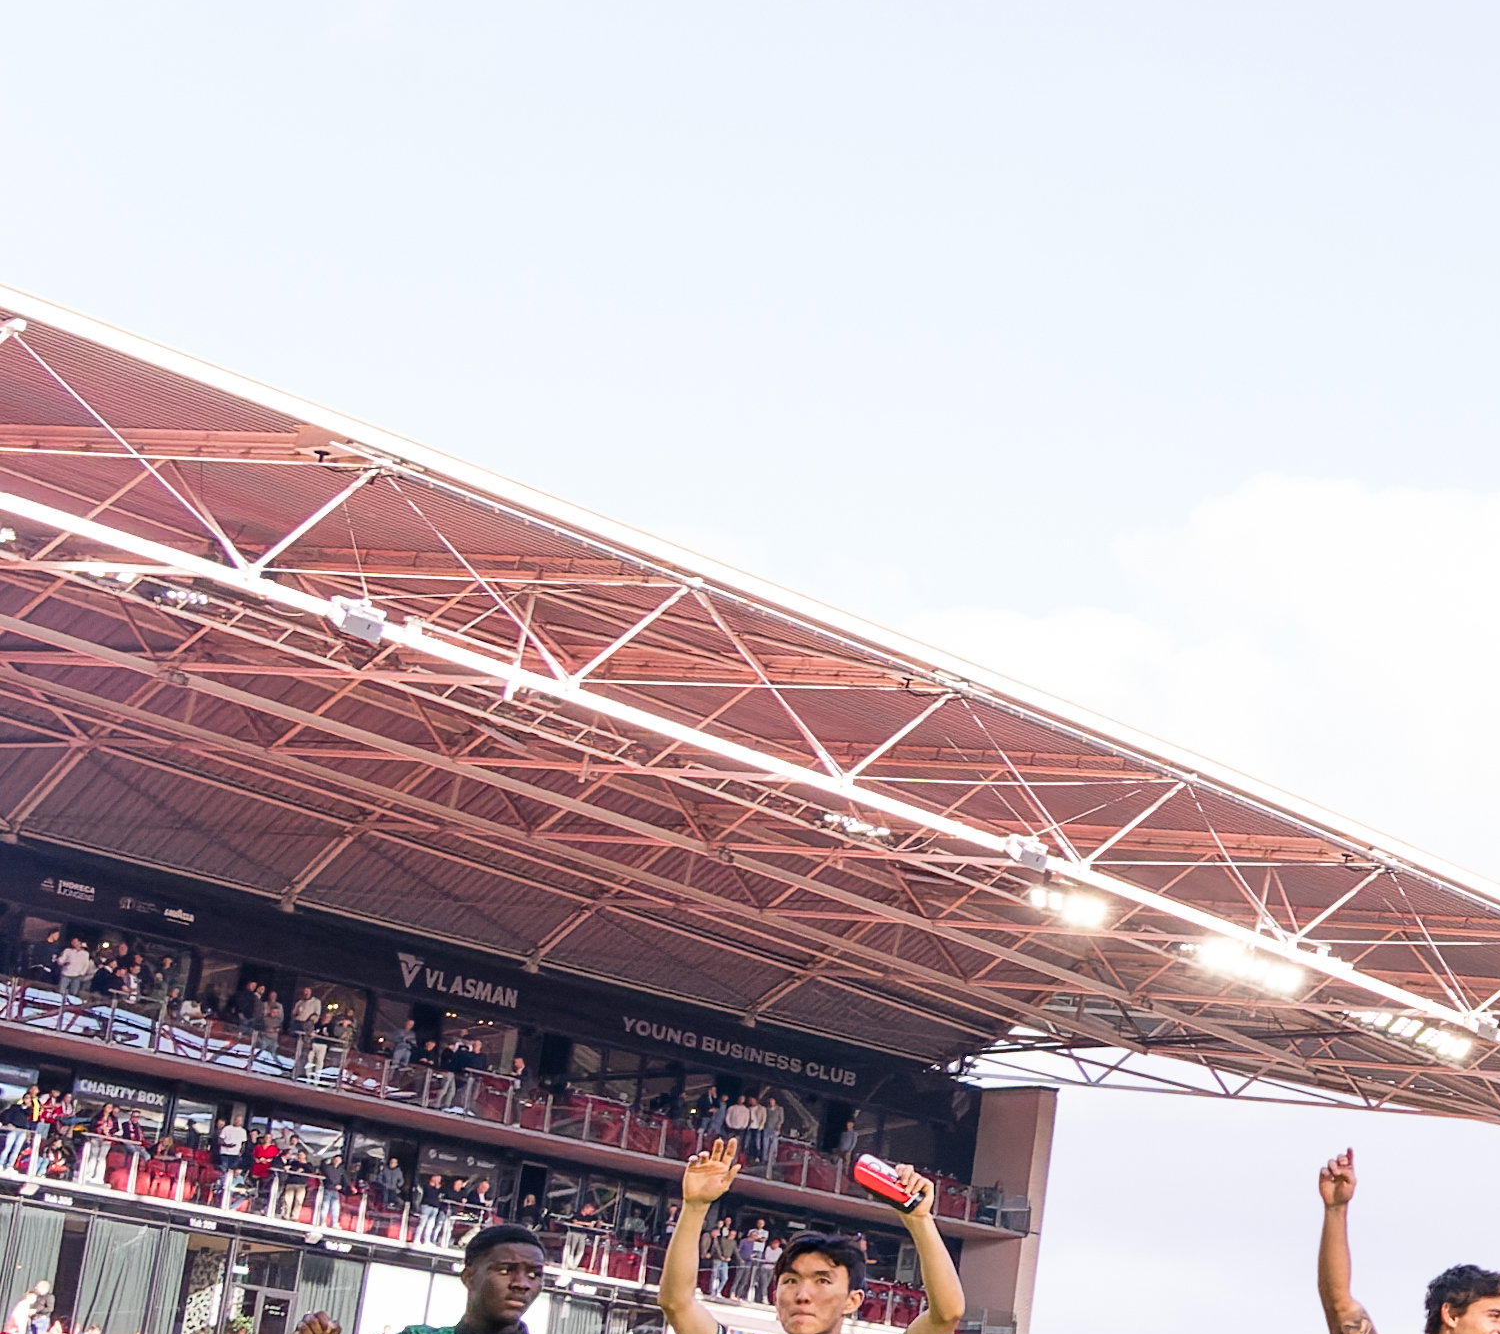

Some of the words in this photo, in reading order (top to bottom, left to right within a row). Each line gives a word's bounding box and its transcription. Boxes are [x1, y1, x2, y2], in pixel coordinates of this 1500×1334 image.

[426, 968, 518, 1009] VLASMAN
[623, 1016, 697, 1048] YOUNG
[702, 1037, 802, 1072] BUSINESS
[805, 1061, 856, 1087] CLUB
[79, 1078, 136, 1101] CHARITY
[137, 1090, 165, 1107] BOX
